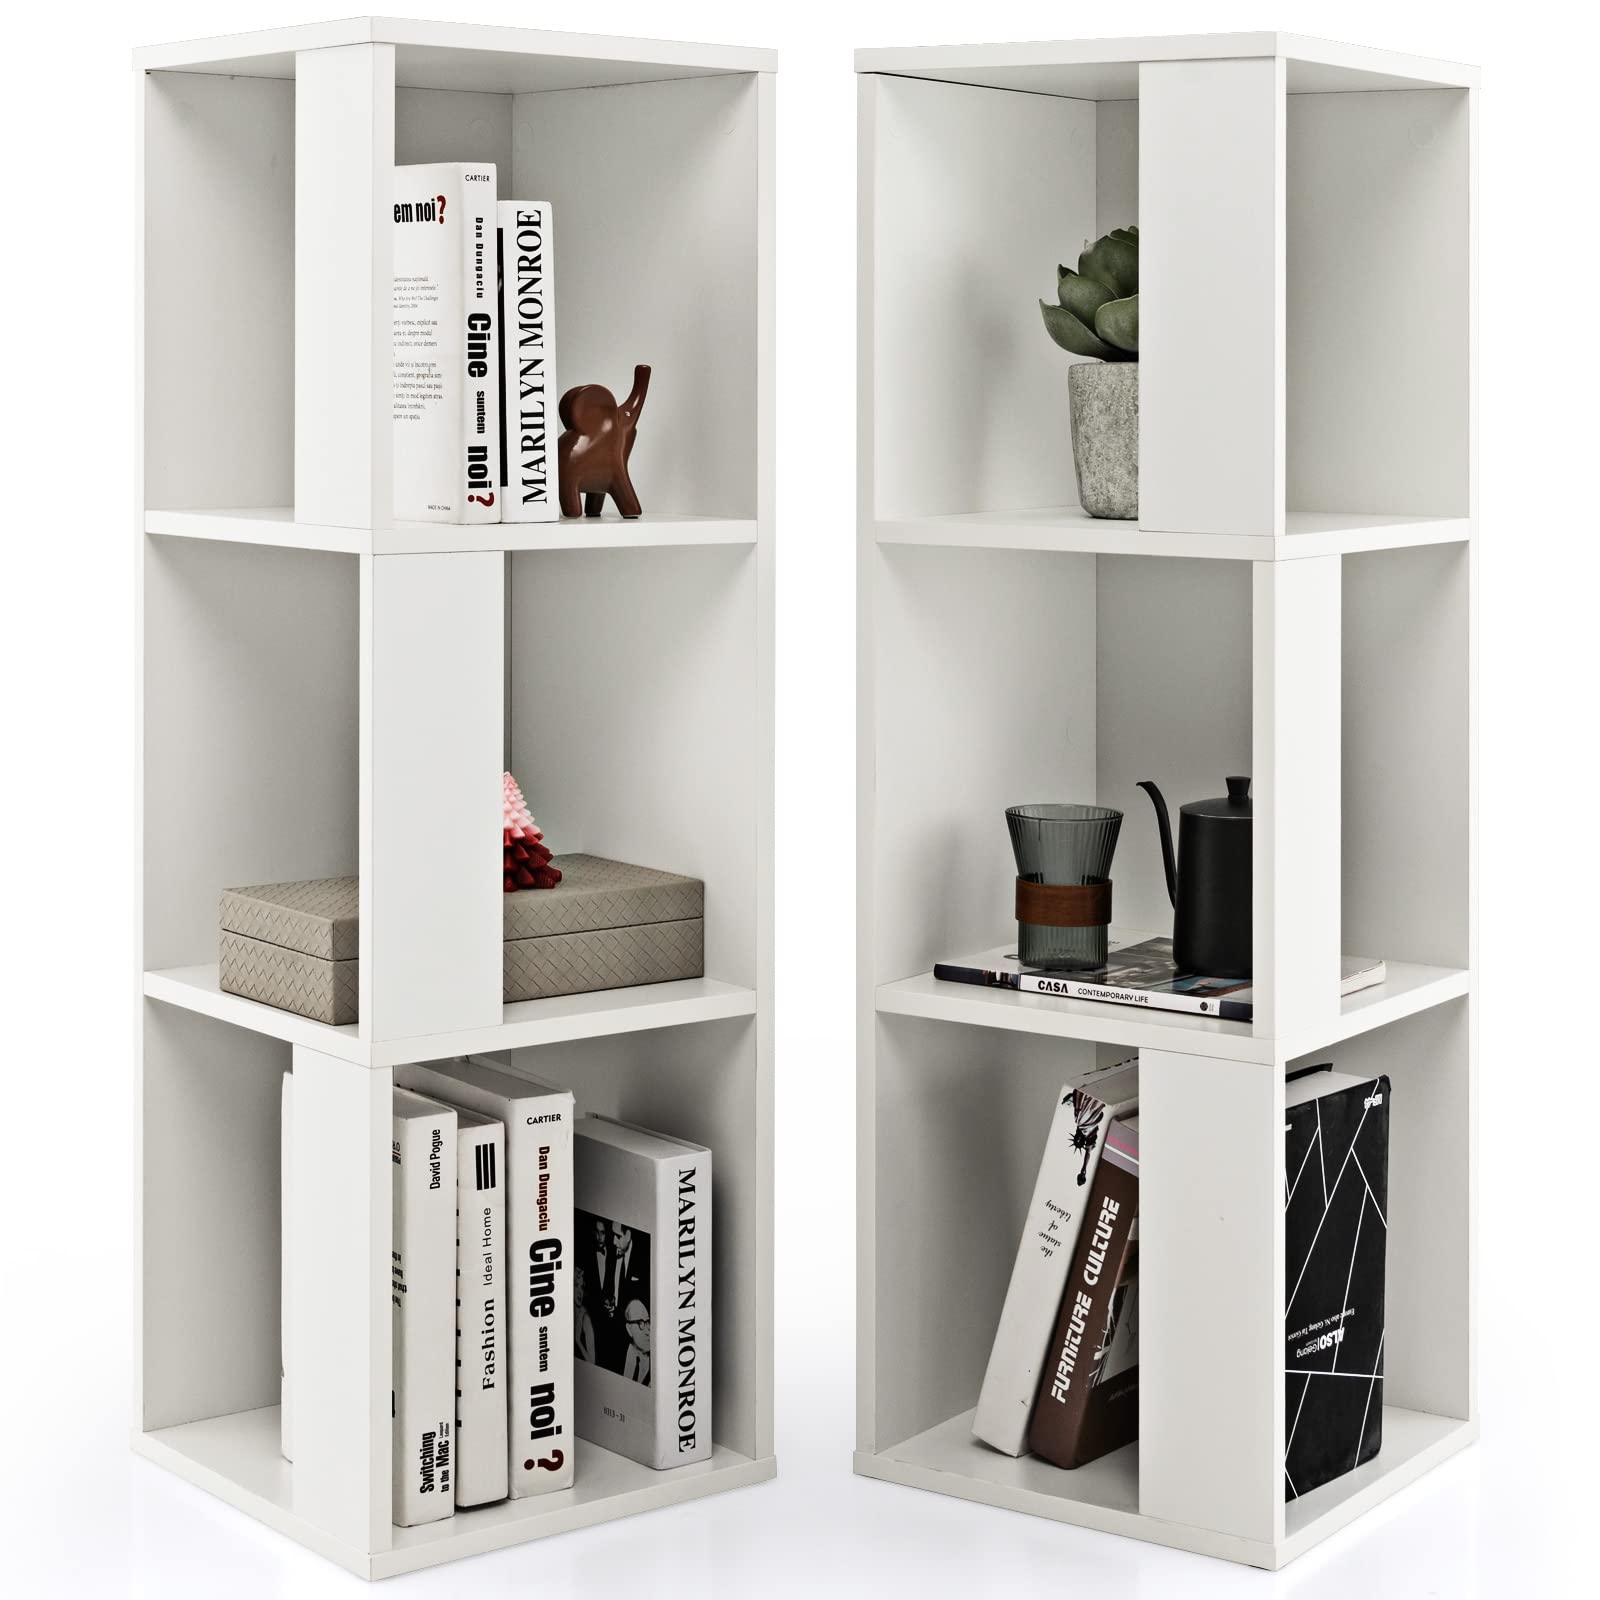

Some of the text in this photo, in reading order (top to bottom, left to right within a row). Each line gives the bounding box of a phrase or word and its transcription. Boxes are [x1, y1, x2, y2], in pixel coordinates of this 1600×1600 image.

[416, 194, 446, 224] noi?
[475, 217, 484, 299] Dan Dungaciu
[516, 209, 548, 506] MARILYN MONROE
[467, 312, 495, 508] Cine suntem noi?
[1038, 980, 1069, 994] CASA
[1078, 988, 1149, 1004] CONTEMPORARY LIFE
[526, 1113, 562, 1125] CARTIER
[430, 1129, 443, 1190] David Pogue
[536, 1146, 550, 1232] Dan Dungaciu
[1045, 1200, 1072, 1222] liberty
[1038, 1231, 1062, 1247] statue
[1040, 1245, 1054, 1258] the
[1048, 1220, 1059, 1232] of
[1083, 1196, 1121, 1286] CULTURE
[481, 1207, 495, 1390] Fashion Ideal Home
[529, 1238, 563, 1318] Cine
[677, 1166, 697, 1454] MARILYN MONROE
[1320, 1326, 1345, 1350] ALSO
[420, 1431, 436, 1494] Switching
[435, 1440, 450, 1492] to the Mac
